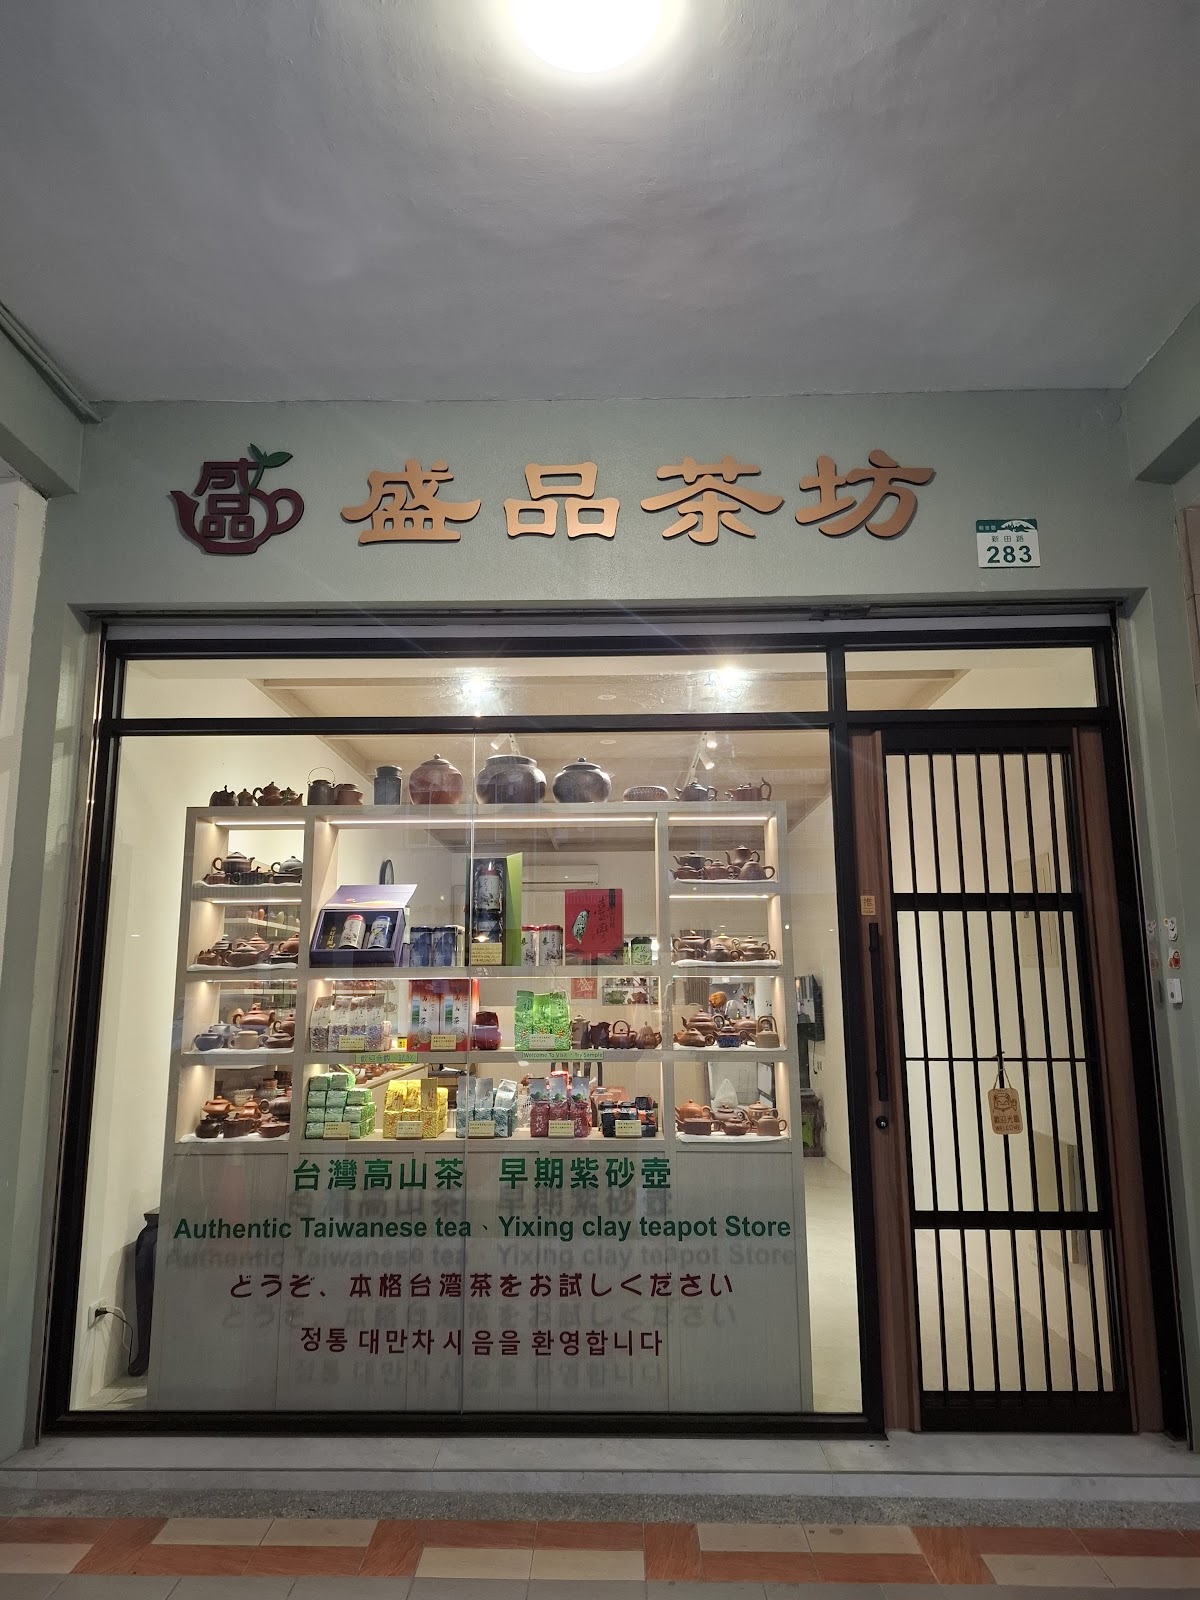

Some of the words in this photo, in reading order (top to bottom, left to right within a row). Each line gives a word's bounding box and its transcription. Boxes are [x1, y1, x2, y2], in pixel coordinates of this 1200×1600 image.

[341, 449, 935, 545] 盛品茶坊
[991, 534, 1024, 543] 新田路
[986, 545, 1032, 564] 283
[995, 1124, 1021, 1132] WELCOME
[293, 1158, 464, 1191] 台灣高山茶
[498, 1157, 671, 1189] 早期紫砂壺
[173, 1217, 292, 1239] Authentic
[300, 1217, 428, 1238] Taiwanese
[582, 1215, 632, 1242] clay
[639, 1216, 717, 1241] teapot
[724, 1215, 791, 1237] Store
[300, 1327, 348, 1353] 정통
[531, 1329, 663, 1357] 환영합니다
